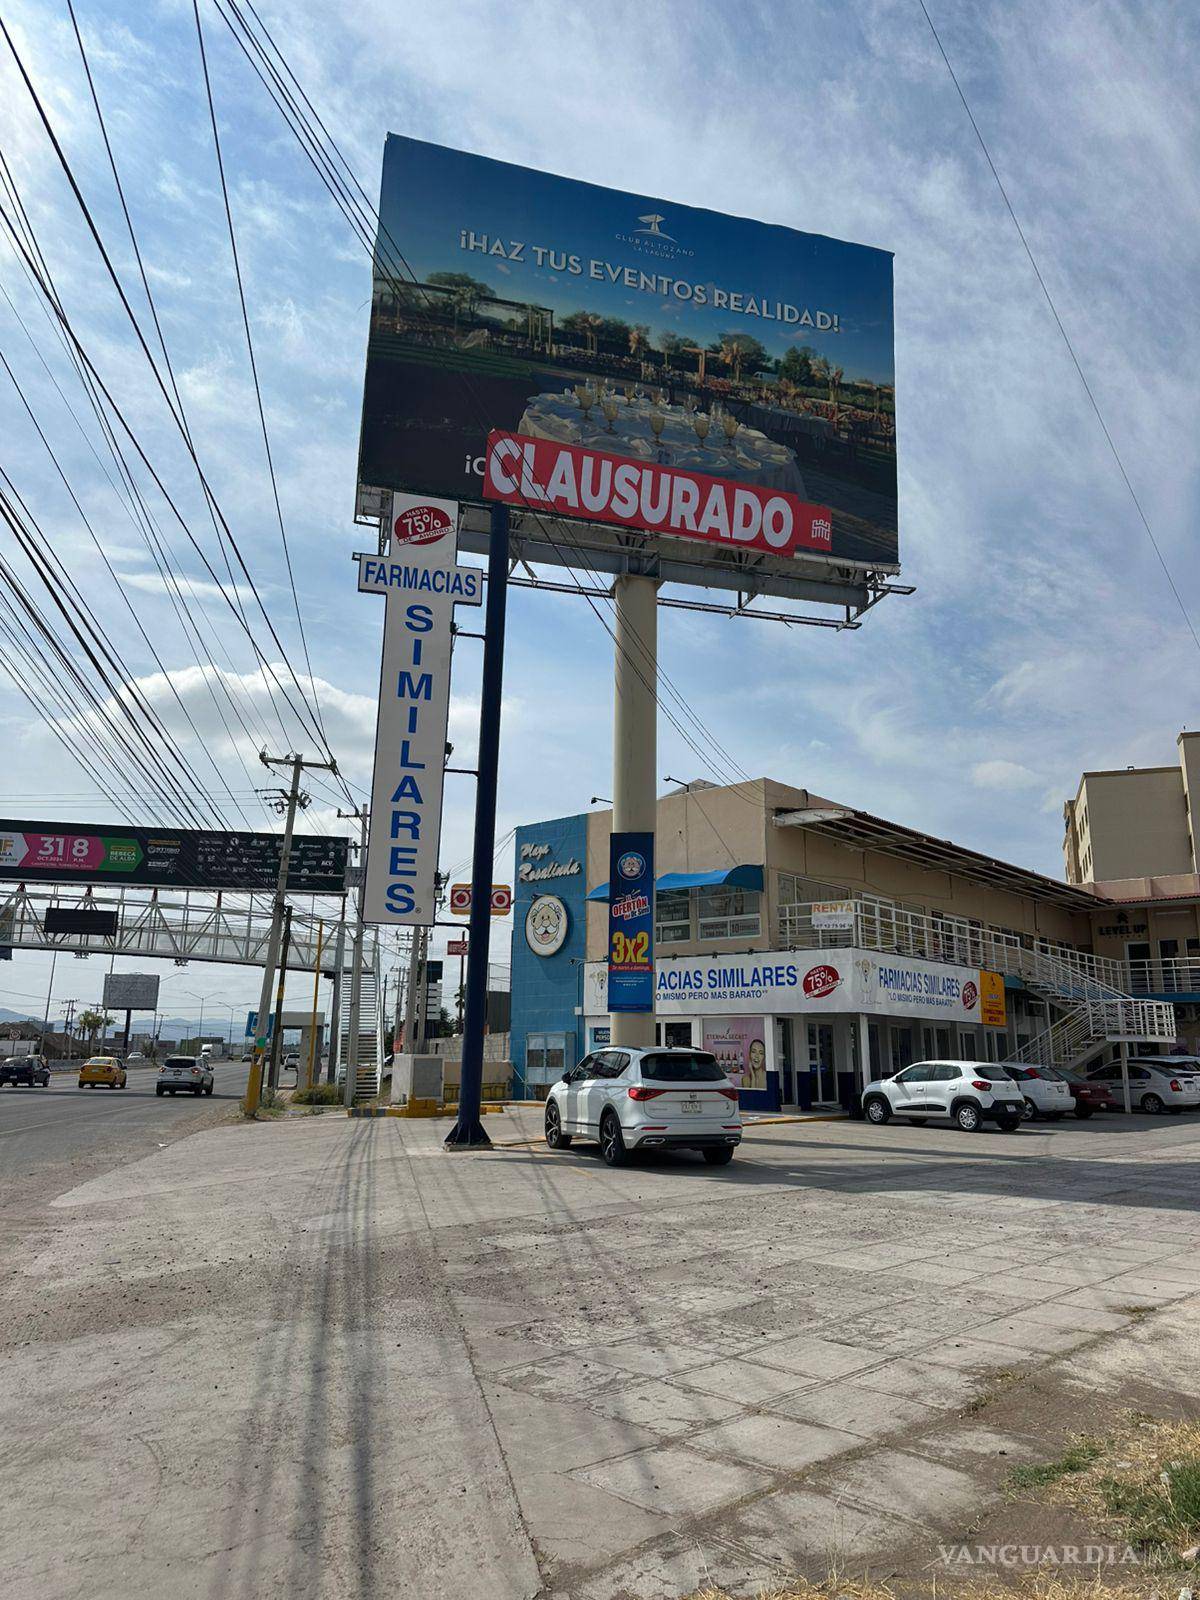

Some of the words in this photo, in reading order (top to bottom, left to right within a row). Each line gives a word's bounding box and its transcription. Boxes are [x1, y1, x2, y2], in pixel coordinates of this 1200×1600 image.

[615, 233, 641, 245] CLUB
[643, 239, 696, 257] ALTOZANO
[460, 230, 525, 262] ¡HAZ
[531, 245, 583, 277] TUS
[588, 260, 708, 305] EVENTOS
[713, 288, 841, 334] REALIDAD!
[488, 437, 794, 549] CLAUSURADO
[402, 512, 442, 535] 75%
[406, 508, 428, 517] HASTA
[419, 528, 450, 539] AHORRO
[364, 561, 477, 597] FARMACIAS
[384, 604, 434, 915] SIMILARES
[38, 836, 65, 856] 31
[72, 838, 89, 857] 8
[453, 890, 509, 908] OO
[813, 903, 853, 913] RENTA
[1098, 926, 1132, 936] LEVEL
[1133, 924, 1146, 934] UP
[612, 931, 650, 964] 3x2
[658, 969, 702, 990] ACIAS
[708, 965, 797, 989] SIMILARES
[808, 970, 833, 990] 75%
[879, 967, 922, 993] FARMACIAS
[923, 974, 960, 998] SIMILARES
[663, 991, 686, 1000] MISMO
[688, 991, 709, 1000] PERO
[711, 991, 728, 999] MAS
[913, 995, 925, 1004] PERO
[926, 997, 936, 1006] MAS
